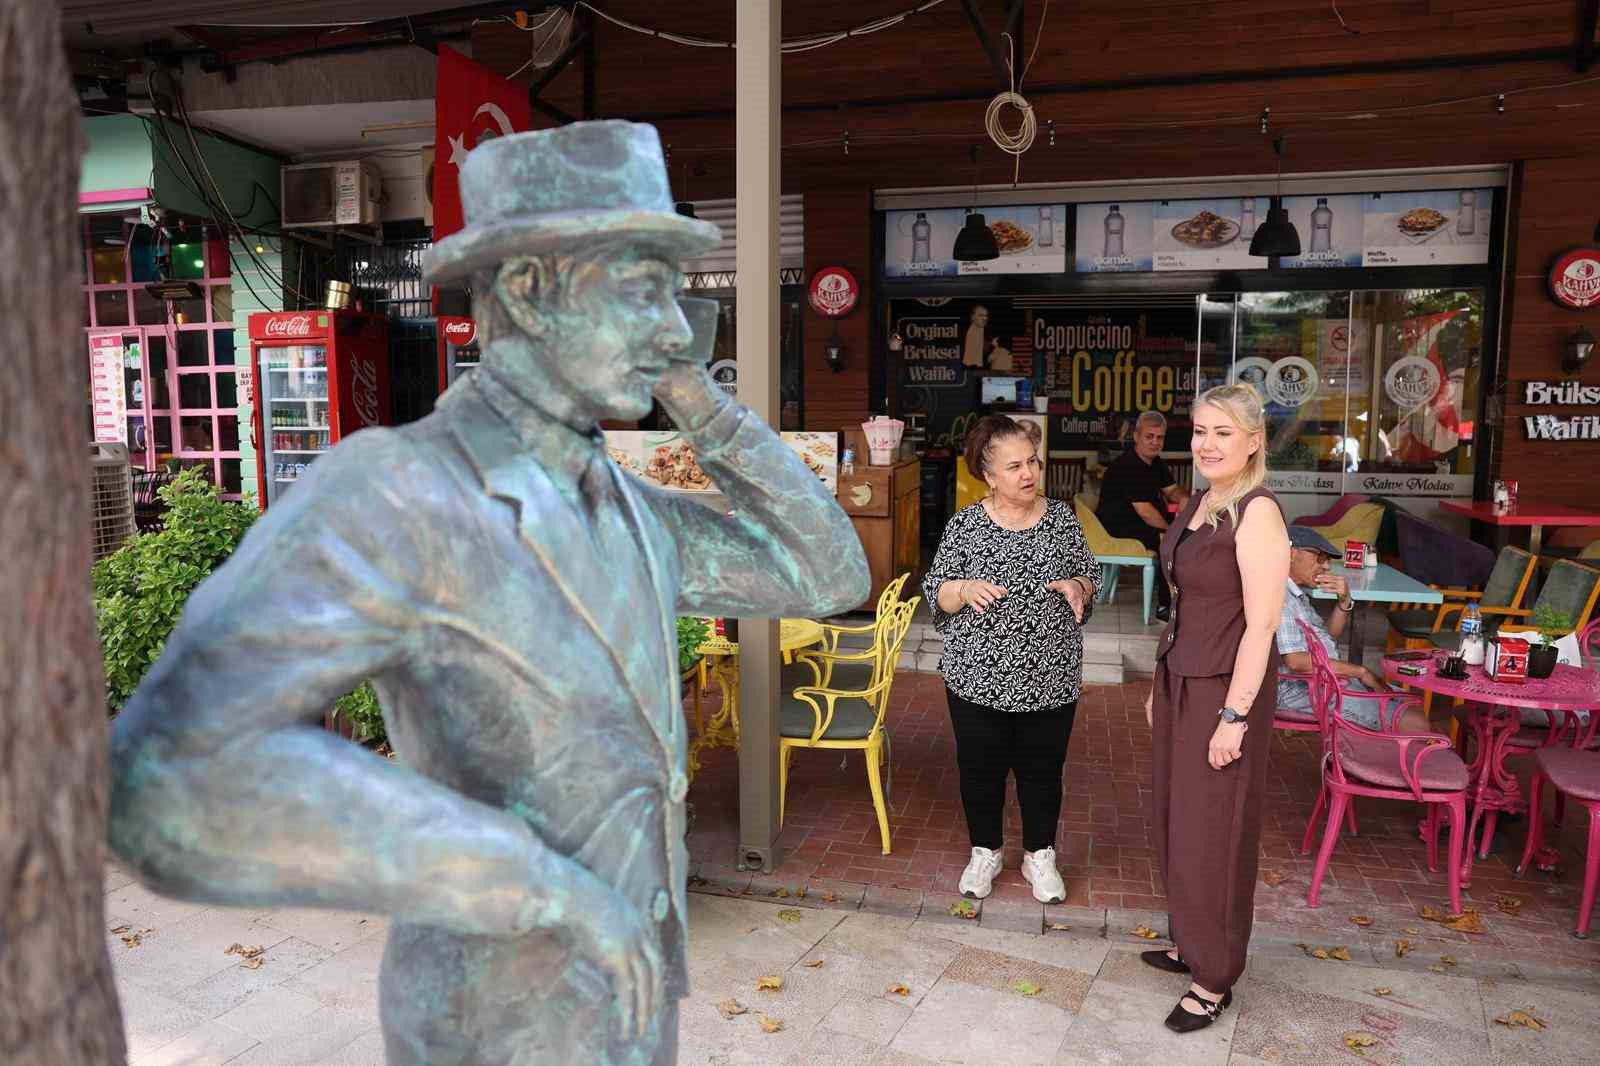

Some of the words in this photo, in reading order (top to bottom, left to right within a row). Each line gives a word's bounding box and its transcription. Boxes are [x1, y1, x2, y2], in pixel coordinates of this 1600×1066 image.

[1034, 316, 1132, 354] Cappuccino
[1072, 351, 1174, 412] Coffee
[1526, 381, 1600, 404] Brüks
[1524, 415, 1600, 440] Waffl
[1361, 477, 1403, 490] Kahve
[1346, 550, 1361, 561] 12
[1505, 654, 1522, 671] 4
